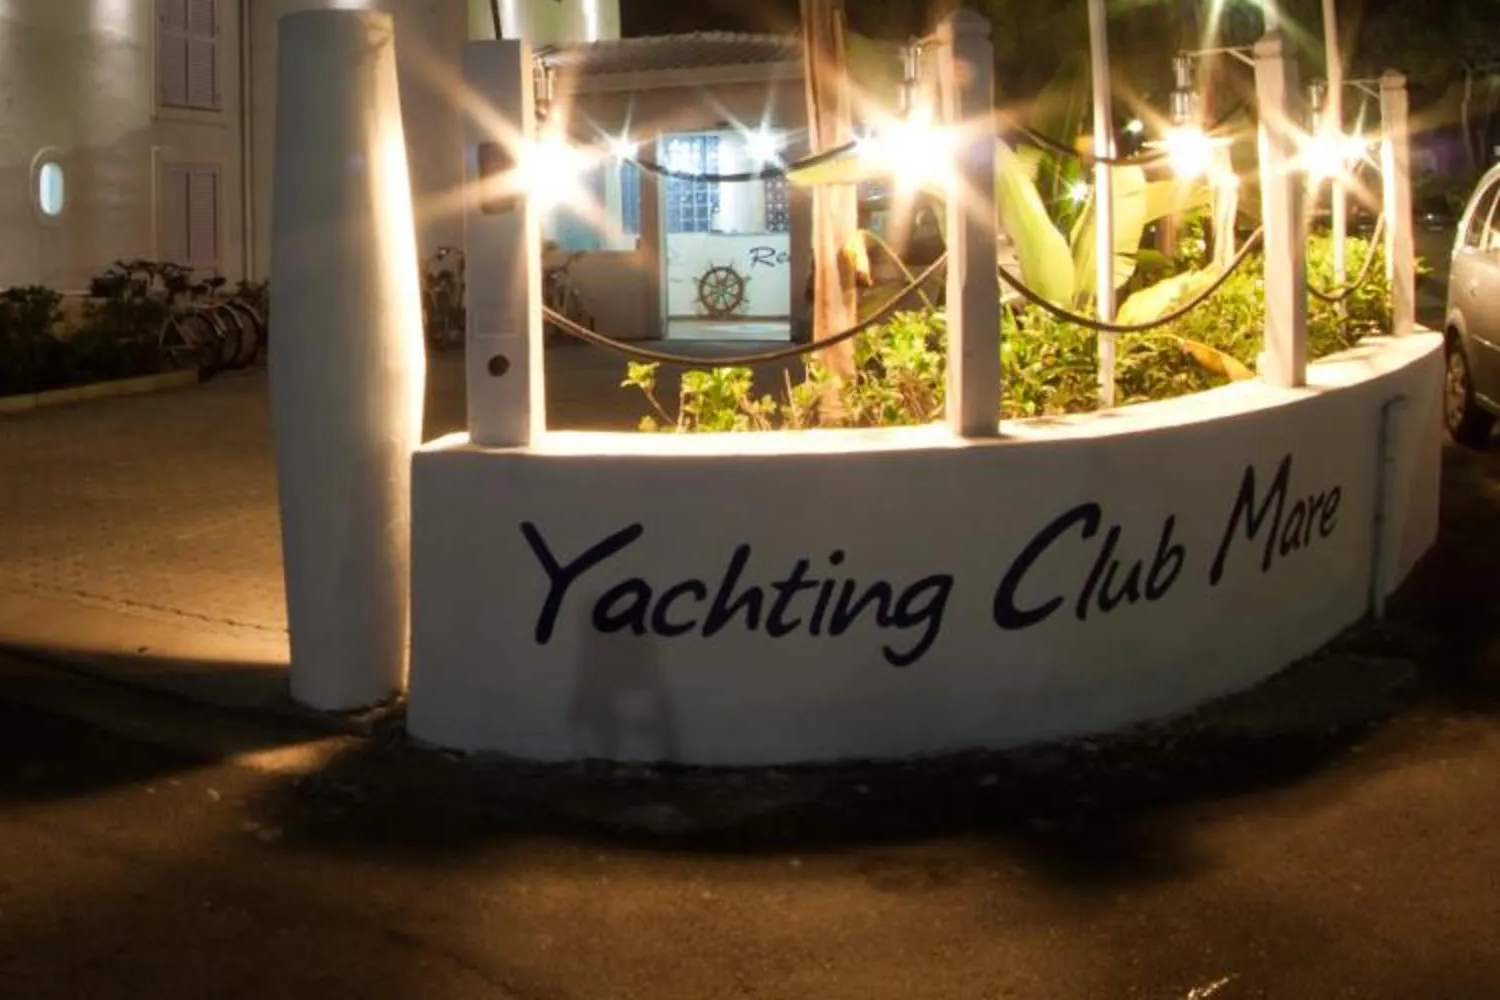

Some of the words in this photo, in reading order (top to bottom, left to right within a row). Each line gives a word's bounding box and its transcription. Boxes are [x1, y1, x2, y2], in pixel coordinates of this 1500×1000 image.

[519, 521, 955, 668] Yachting
[993, 502, 1186, 631] Club
[1209, 453, 1342, 587] Mare
